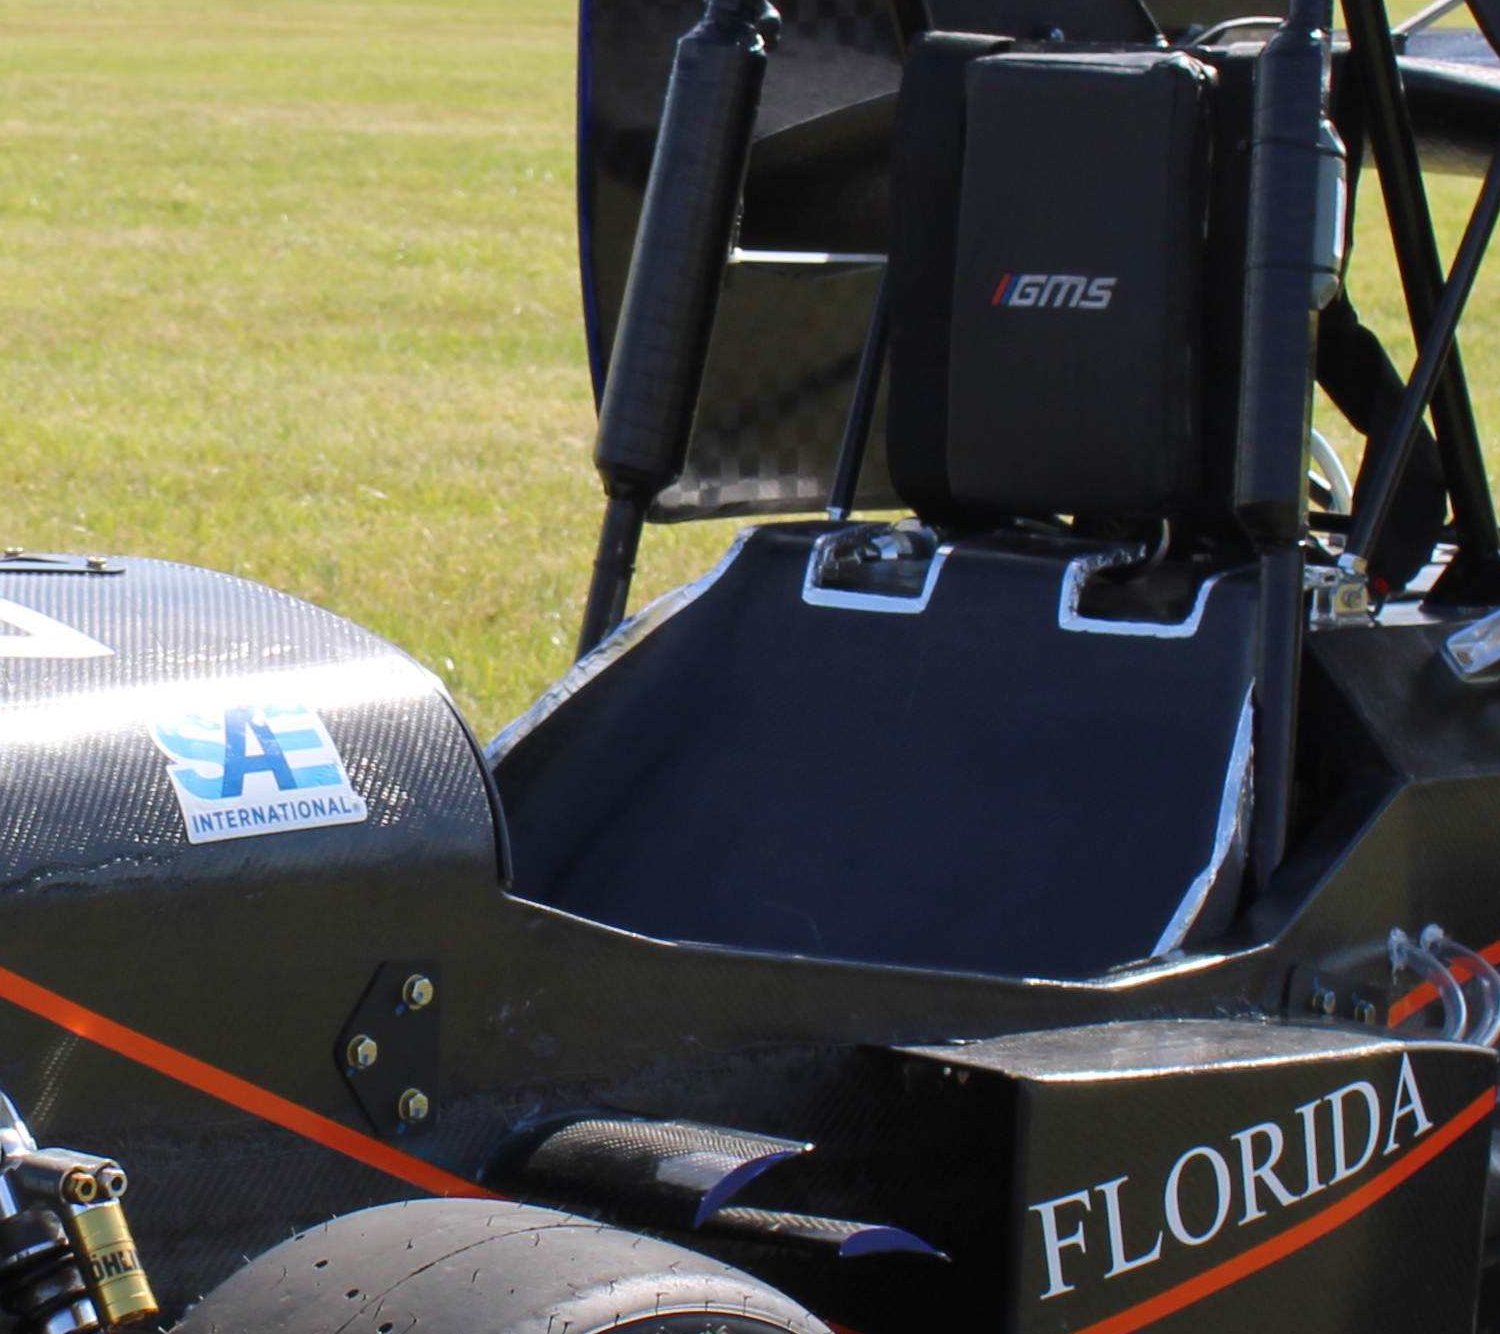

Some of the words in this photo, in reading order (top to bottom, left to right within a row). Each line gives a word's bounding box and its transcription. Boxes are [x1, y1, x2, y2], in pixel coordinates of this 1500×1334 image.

[1008, 274, 1118, 310] GMS
[156, 704, 343, 800] SAE
[192, 796, 352, 835] INTERNATIONAL
[1028, 1052, 1433, 1300] FLORIDA
